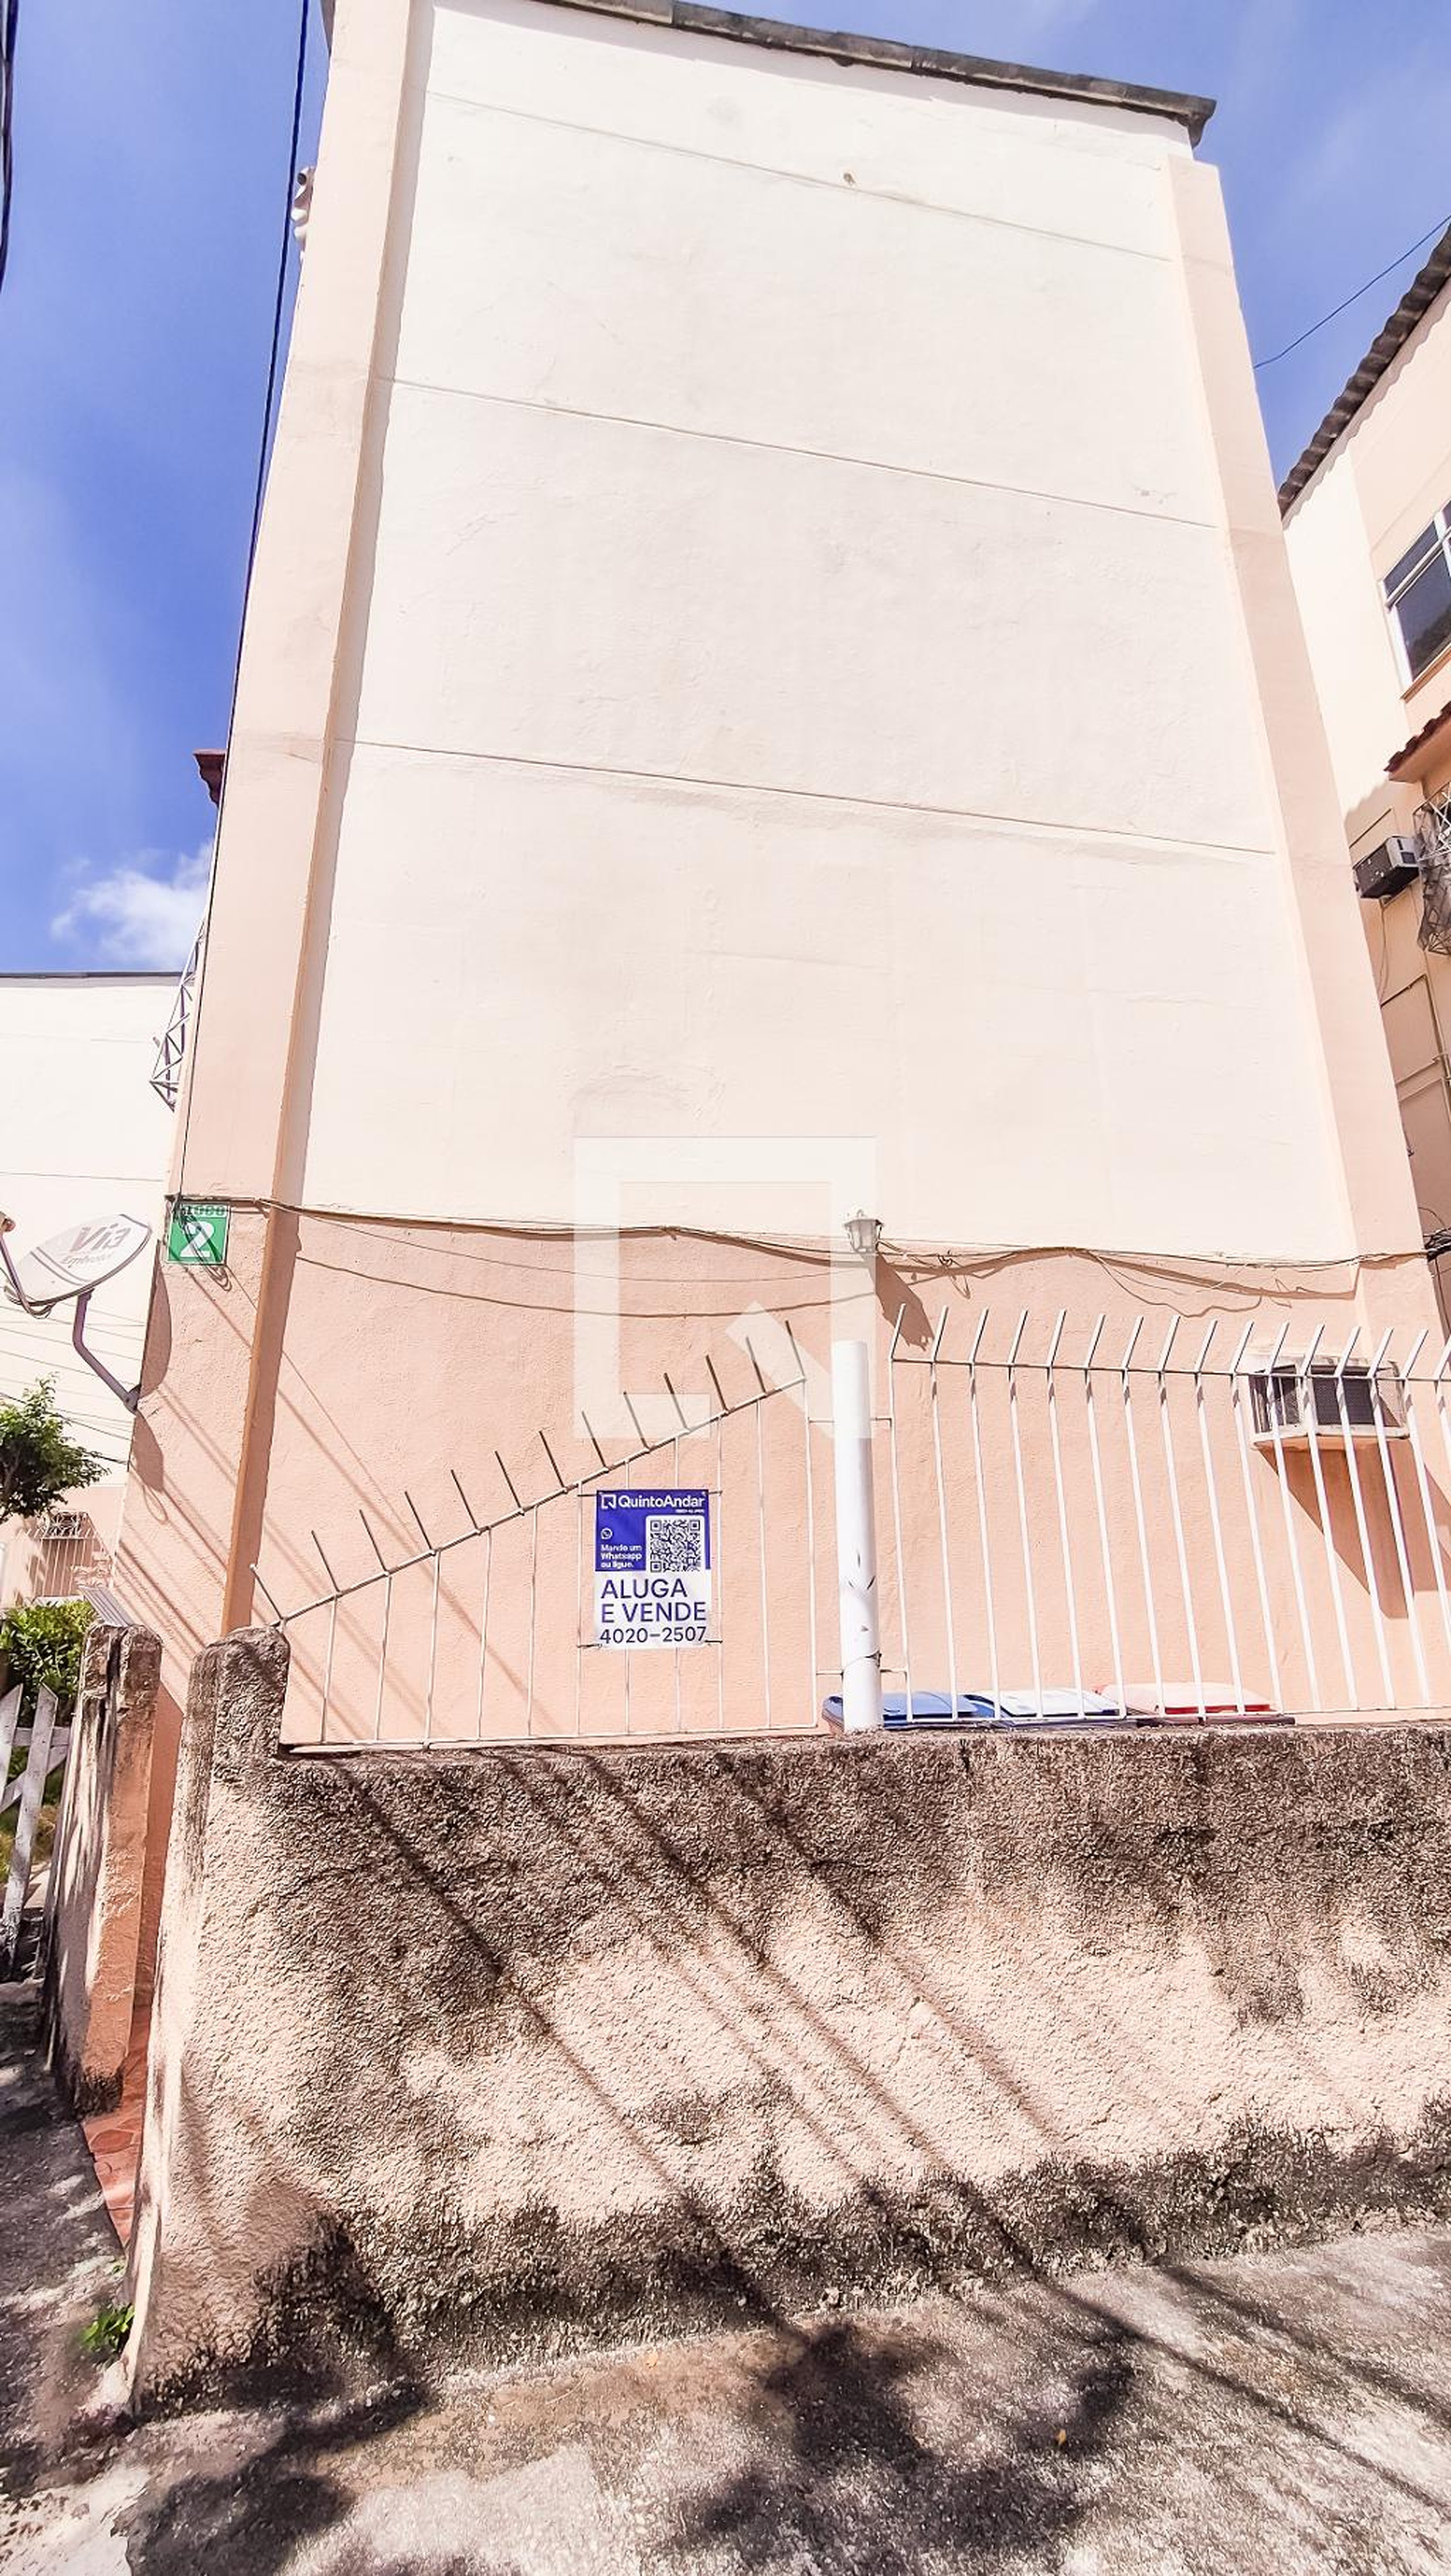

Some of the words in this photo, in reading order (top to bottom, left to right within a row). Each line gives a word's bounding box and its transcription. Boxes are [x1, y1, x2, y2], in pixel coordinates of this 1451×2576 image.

[179, 1221, 215, 1257] 2
[618, 1495, 705, 1508] QuintoAndar
[600, 1578, 688, 1599] ALUGA
[602, 1603, 614, 1623] E
[622, 1602, 706, 1622] VENDE
[600, 1626, 706, 1644] 4020-2507
